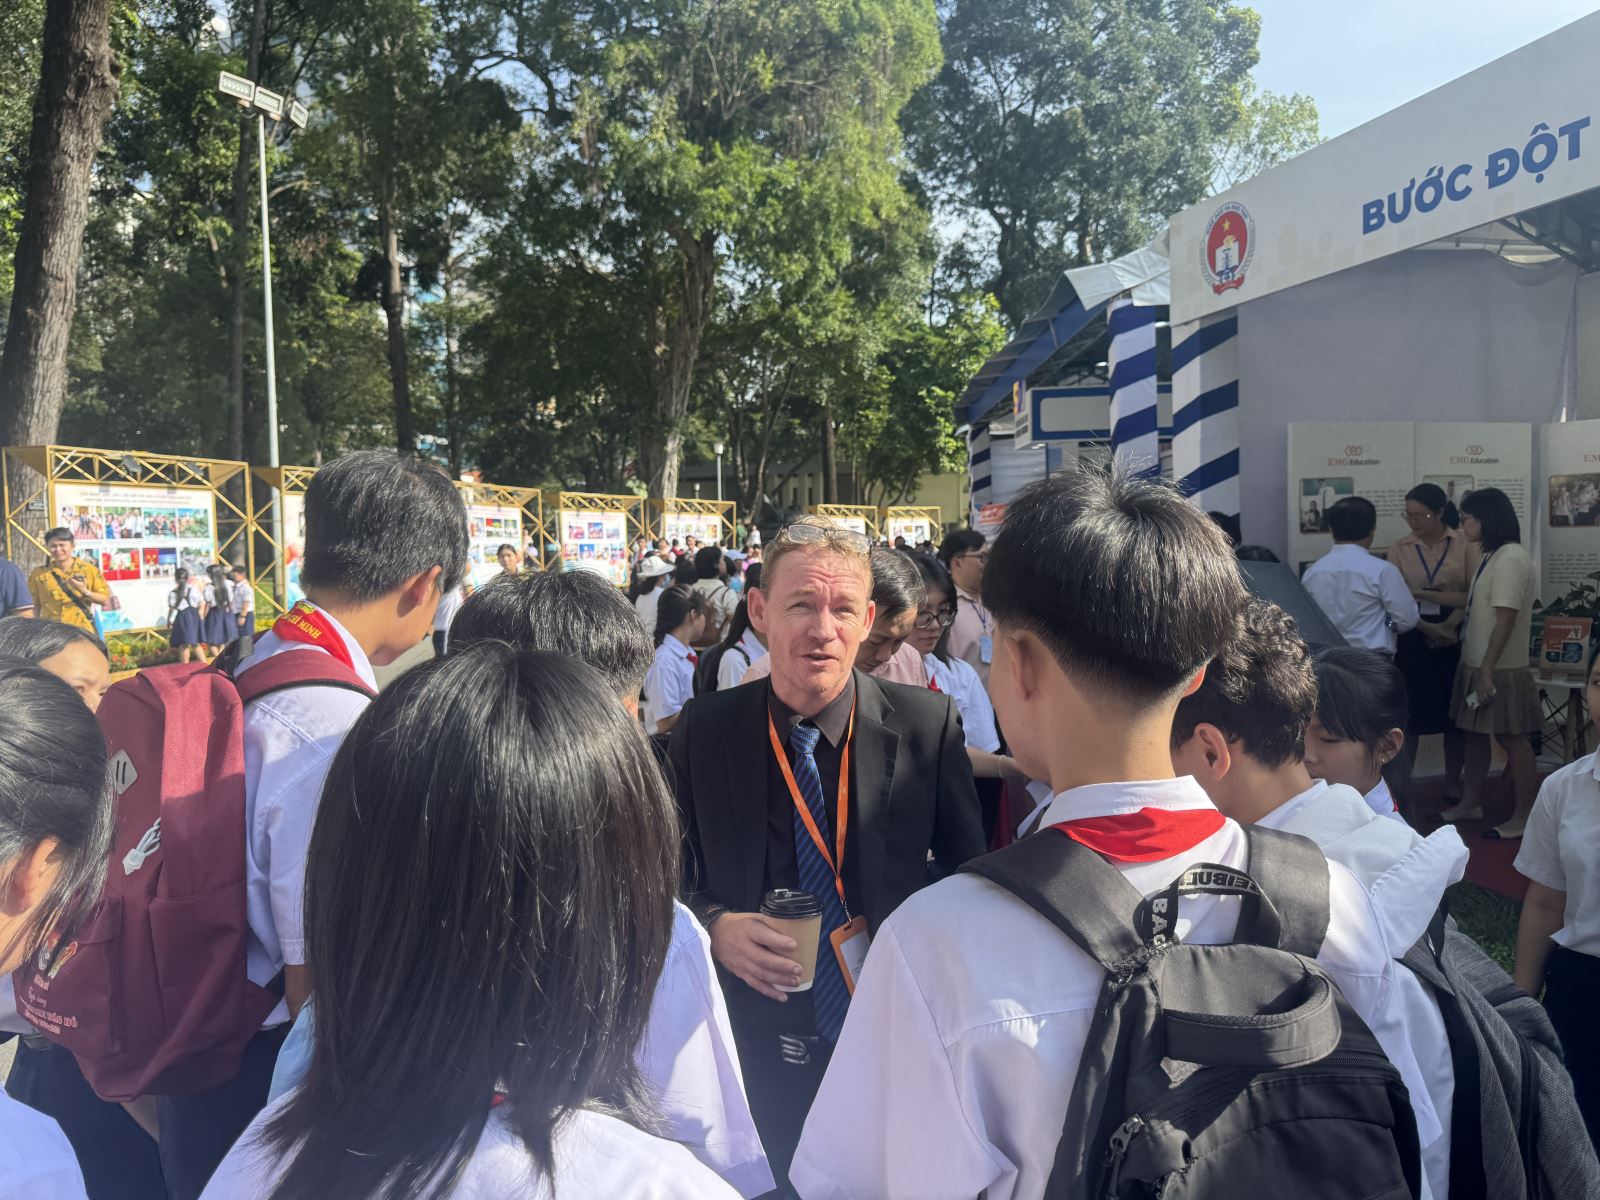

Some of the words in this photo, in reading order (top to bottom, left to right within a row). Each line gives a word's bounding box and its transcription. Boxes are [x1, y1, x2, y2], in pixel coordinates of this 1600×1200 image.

[1362, 164, 1473, 235] BƯỚC
[1484, 116, 1591, 188] ĐỘT
[298, 619, 322, 638] MINH
